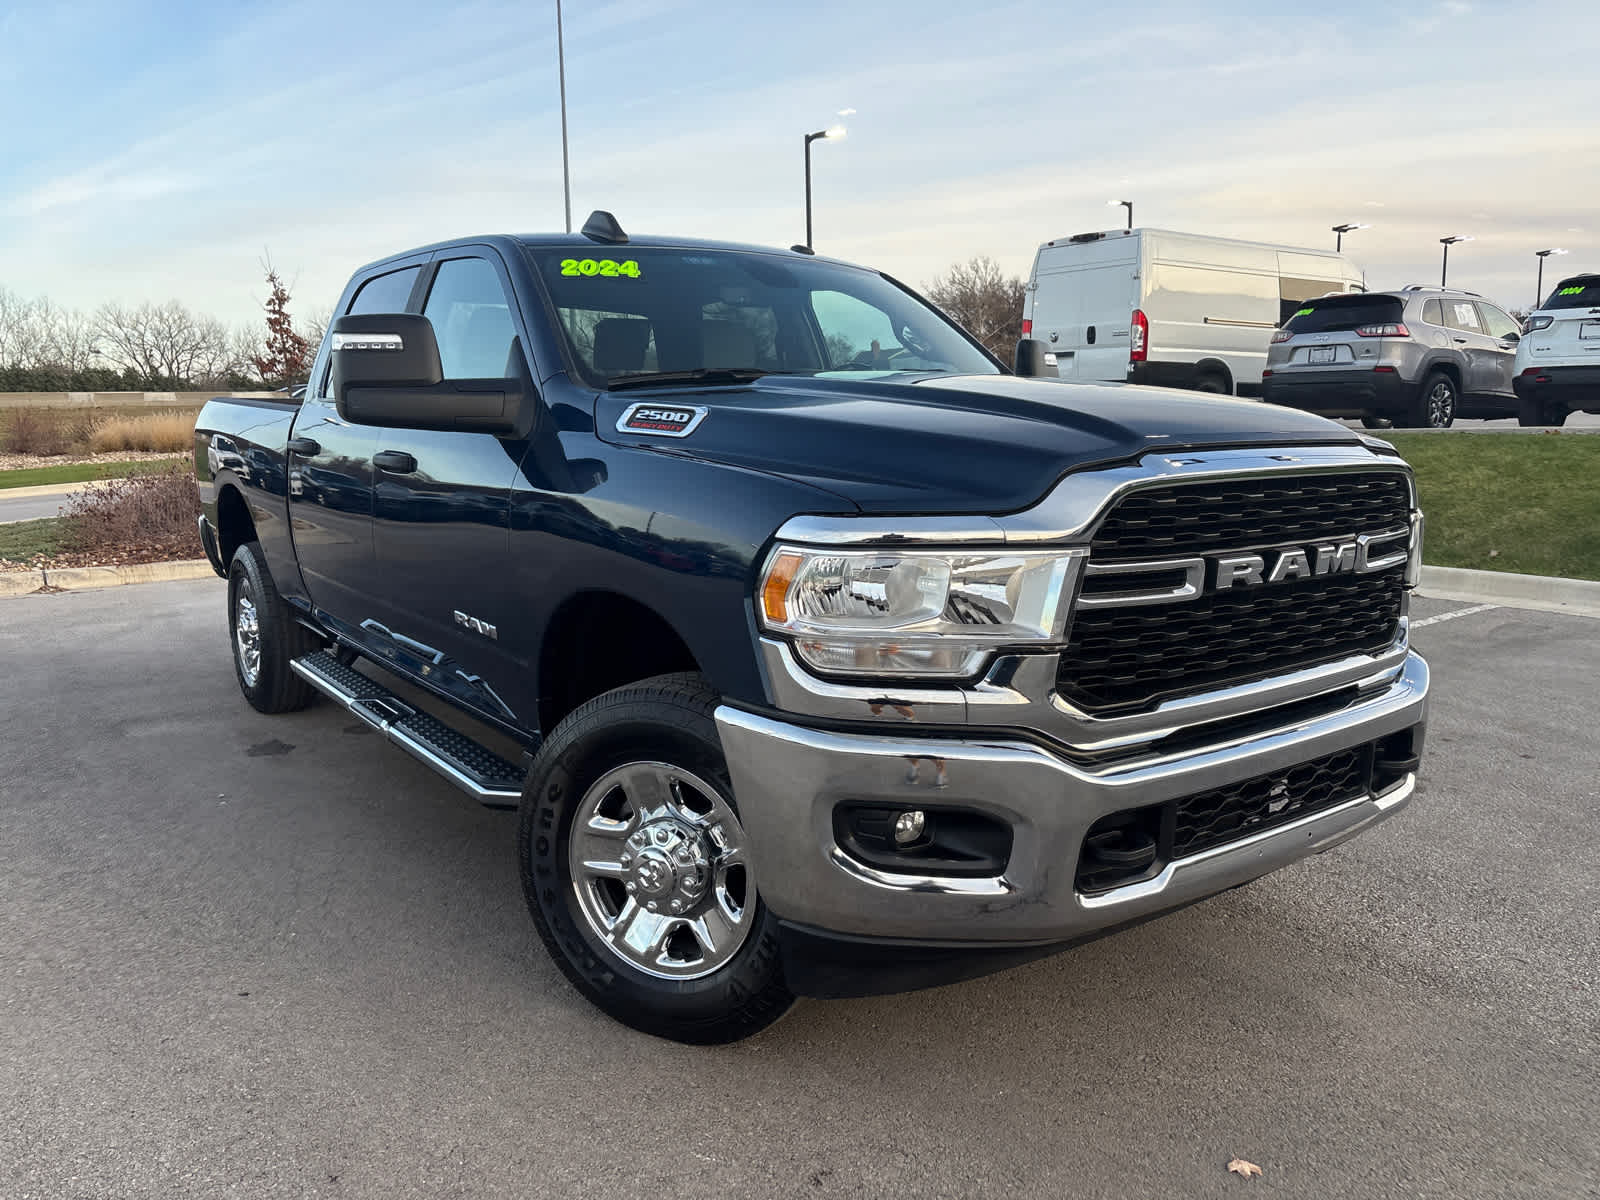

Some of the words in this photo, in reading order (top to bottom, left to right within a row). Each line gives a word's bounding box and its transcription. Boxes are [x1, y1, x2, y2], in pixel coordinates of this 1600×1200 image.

[560, 258, 641, 278] 2024
[635, 409, 690, 423] 2500
[1215, 542, 1357, 589] RAM
[453, 609, 498, 641] RAM
